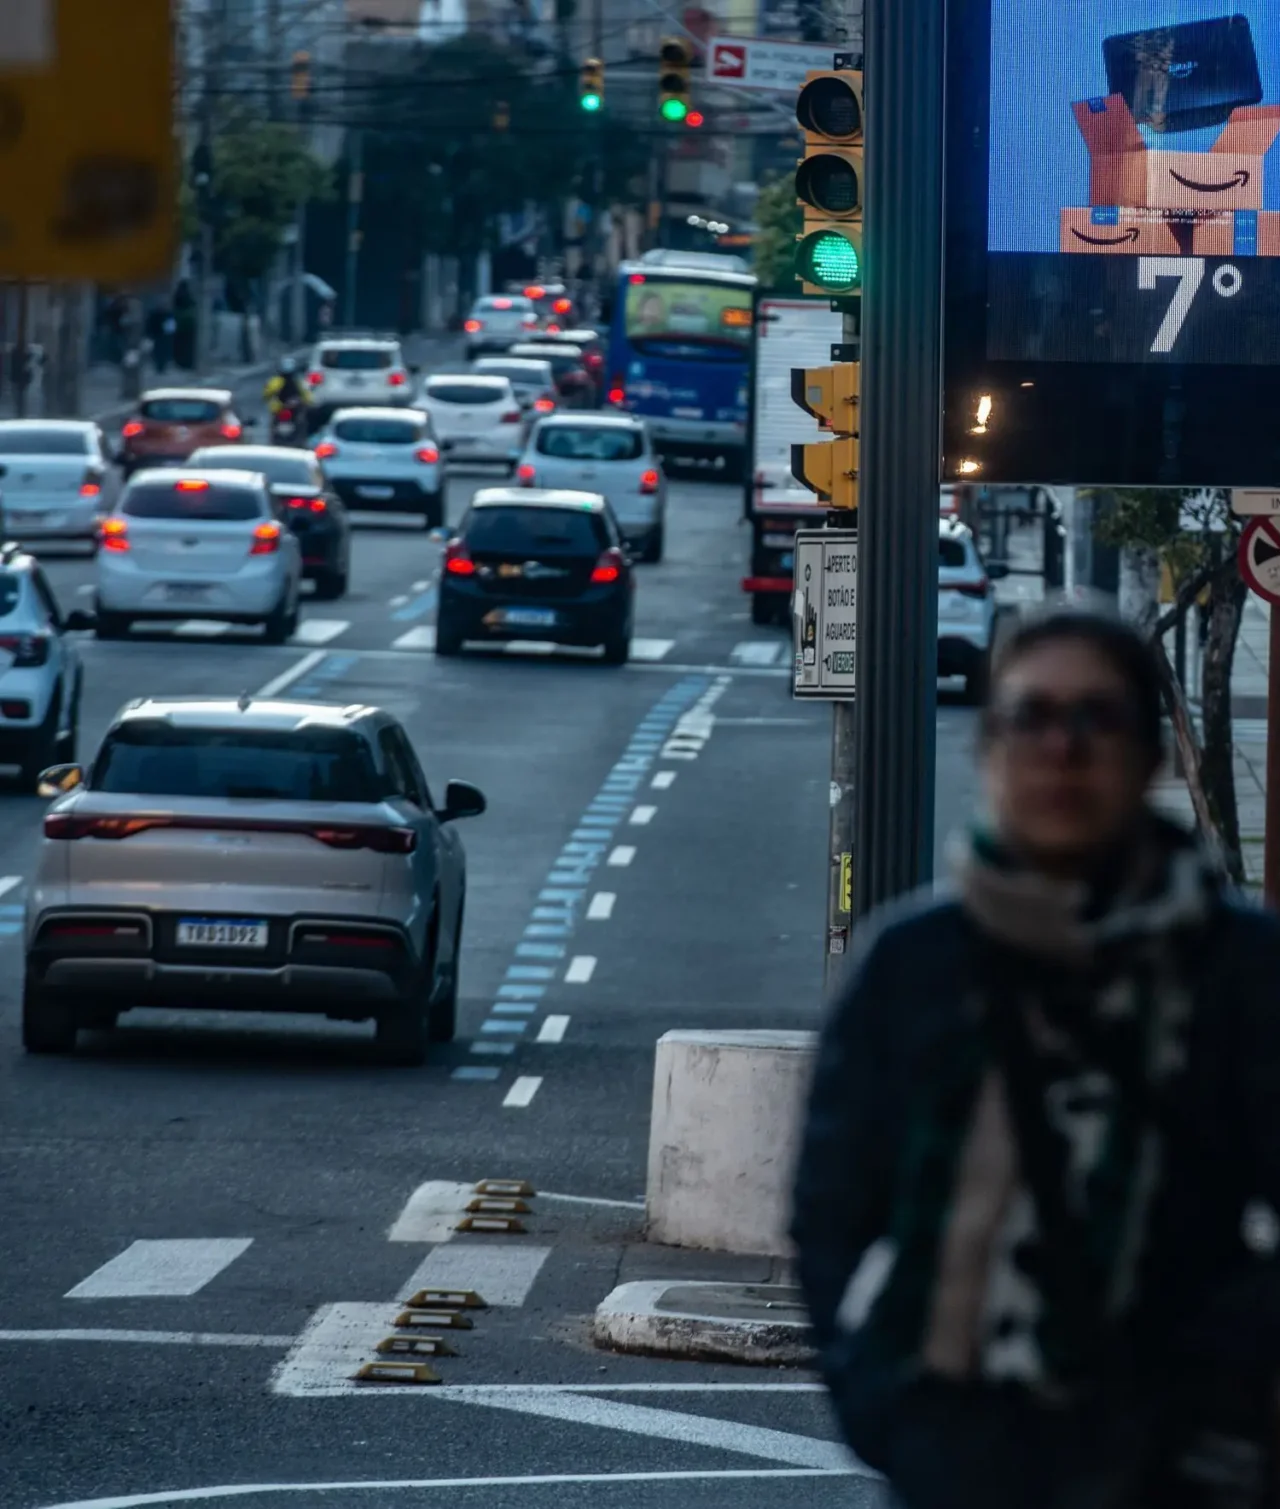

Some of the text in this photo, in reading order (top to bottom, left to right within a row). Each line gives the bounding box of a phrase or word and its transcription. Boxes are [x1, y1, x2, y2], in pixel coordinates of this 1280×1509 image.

[826, 555, 851, 573] APERTE
[827, 585, 855, 607] BOTÃO E
[825, 622, 856, 641] AGUARDE
[832, 652, 855, 673] VERDE
